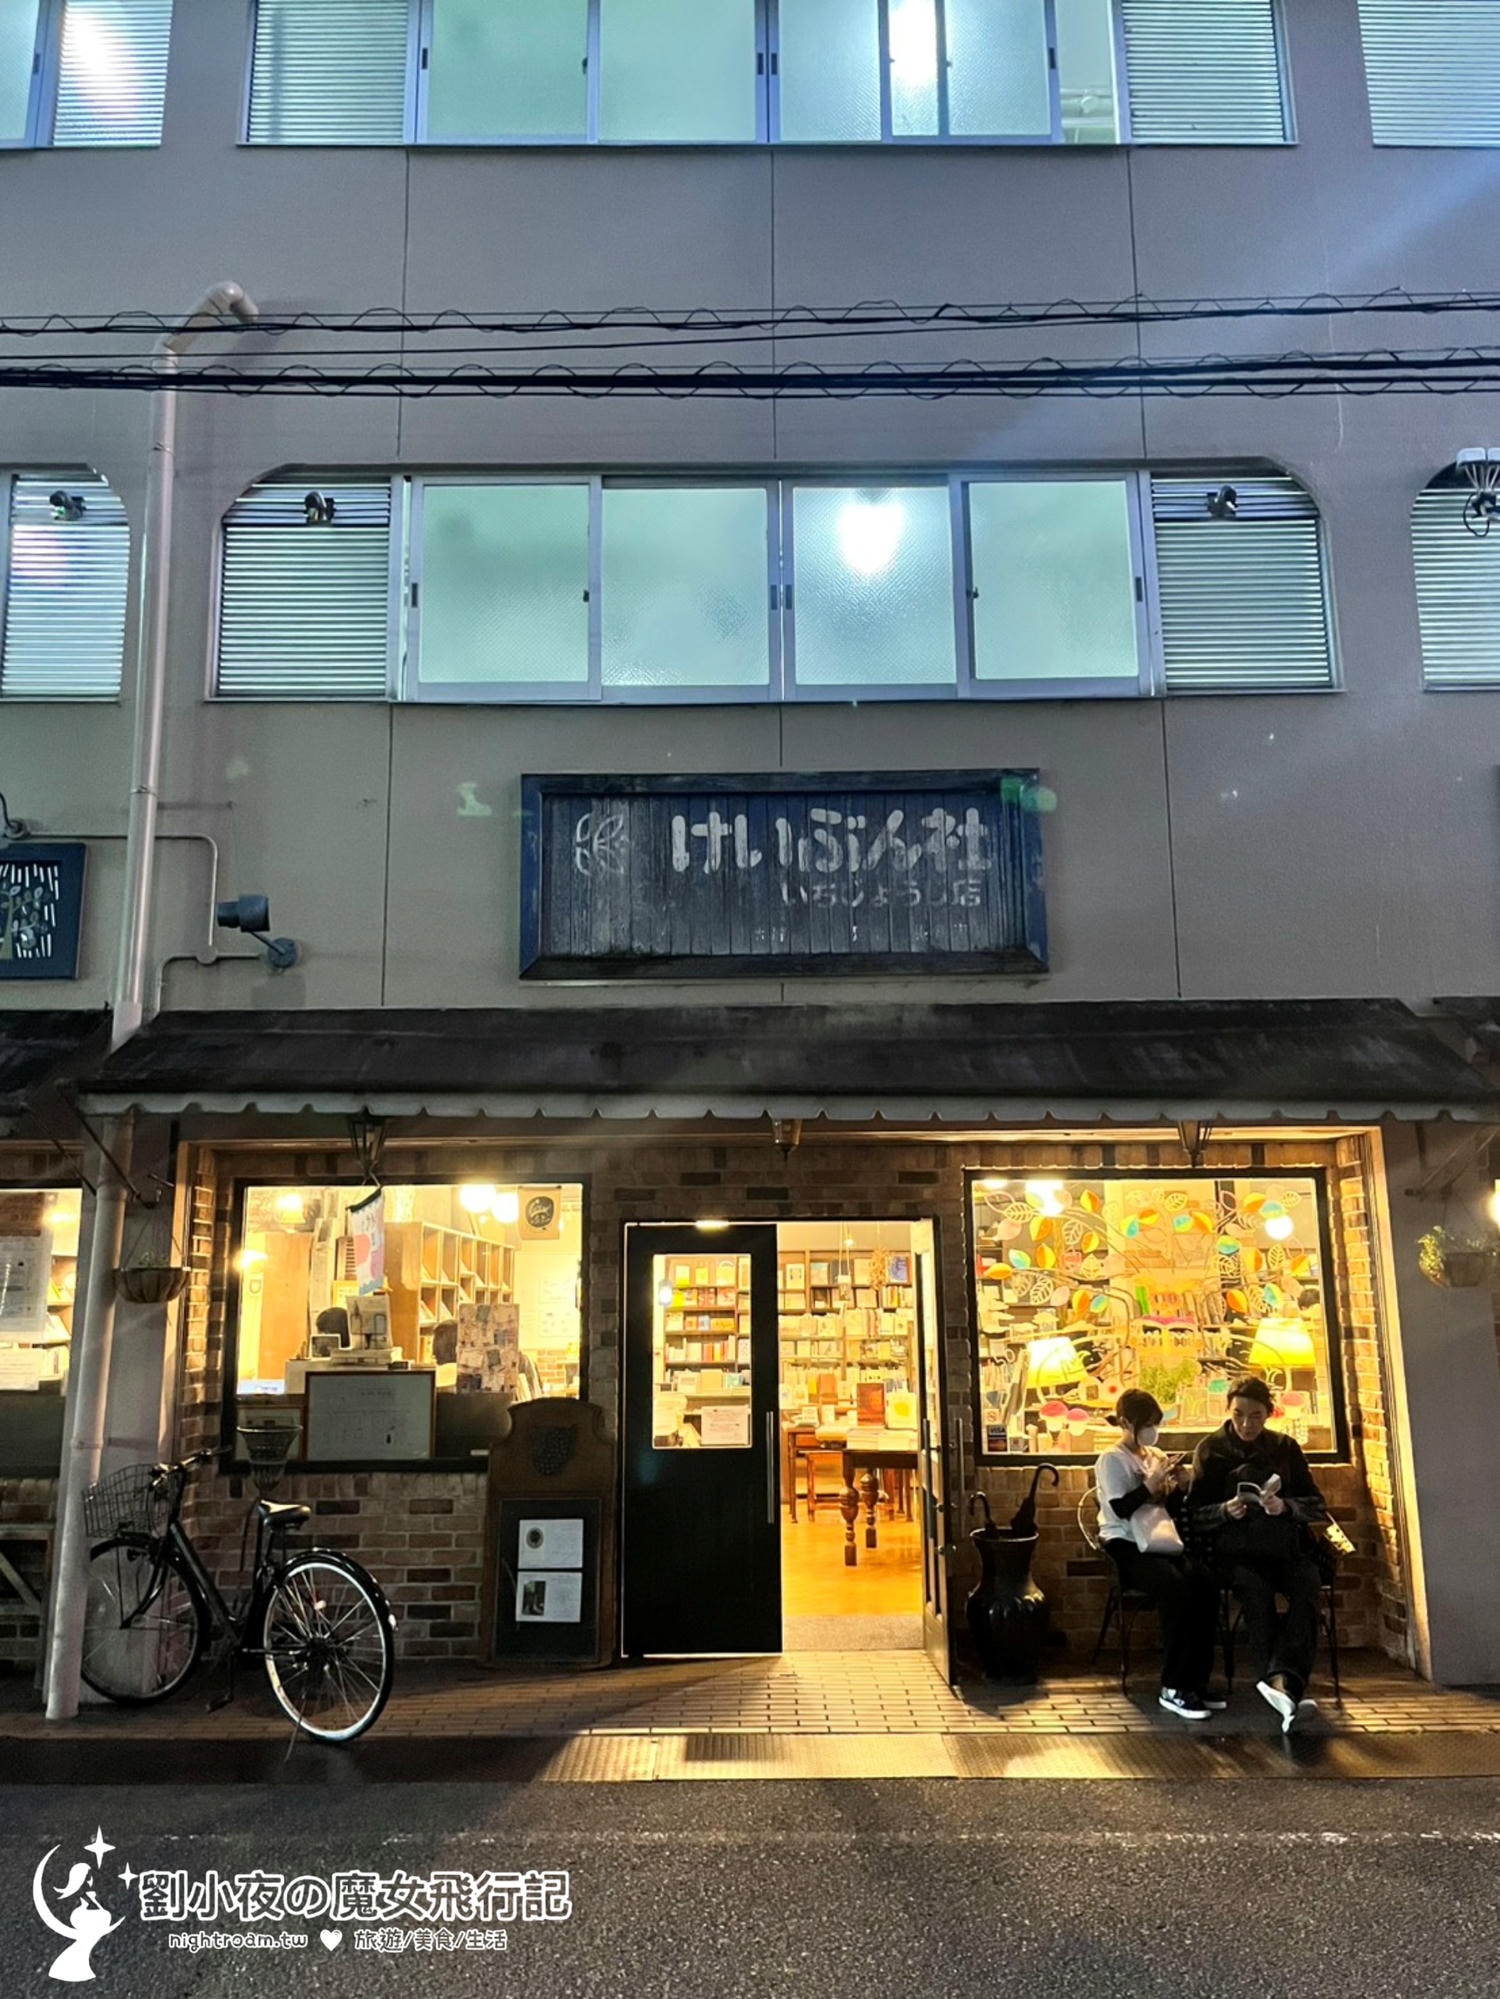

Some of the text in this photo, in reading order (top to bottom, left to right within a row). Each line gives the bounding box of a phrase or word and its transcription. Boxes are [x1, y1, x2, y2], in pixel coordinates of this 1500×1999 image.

[671, 808, 992, 874] けいぶん社
